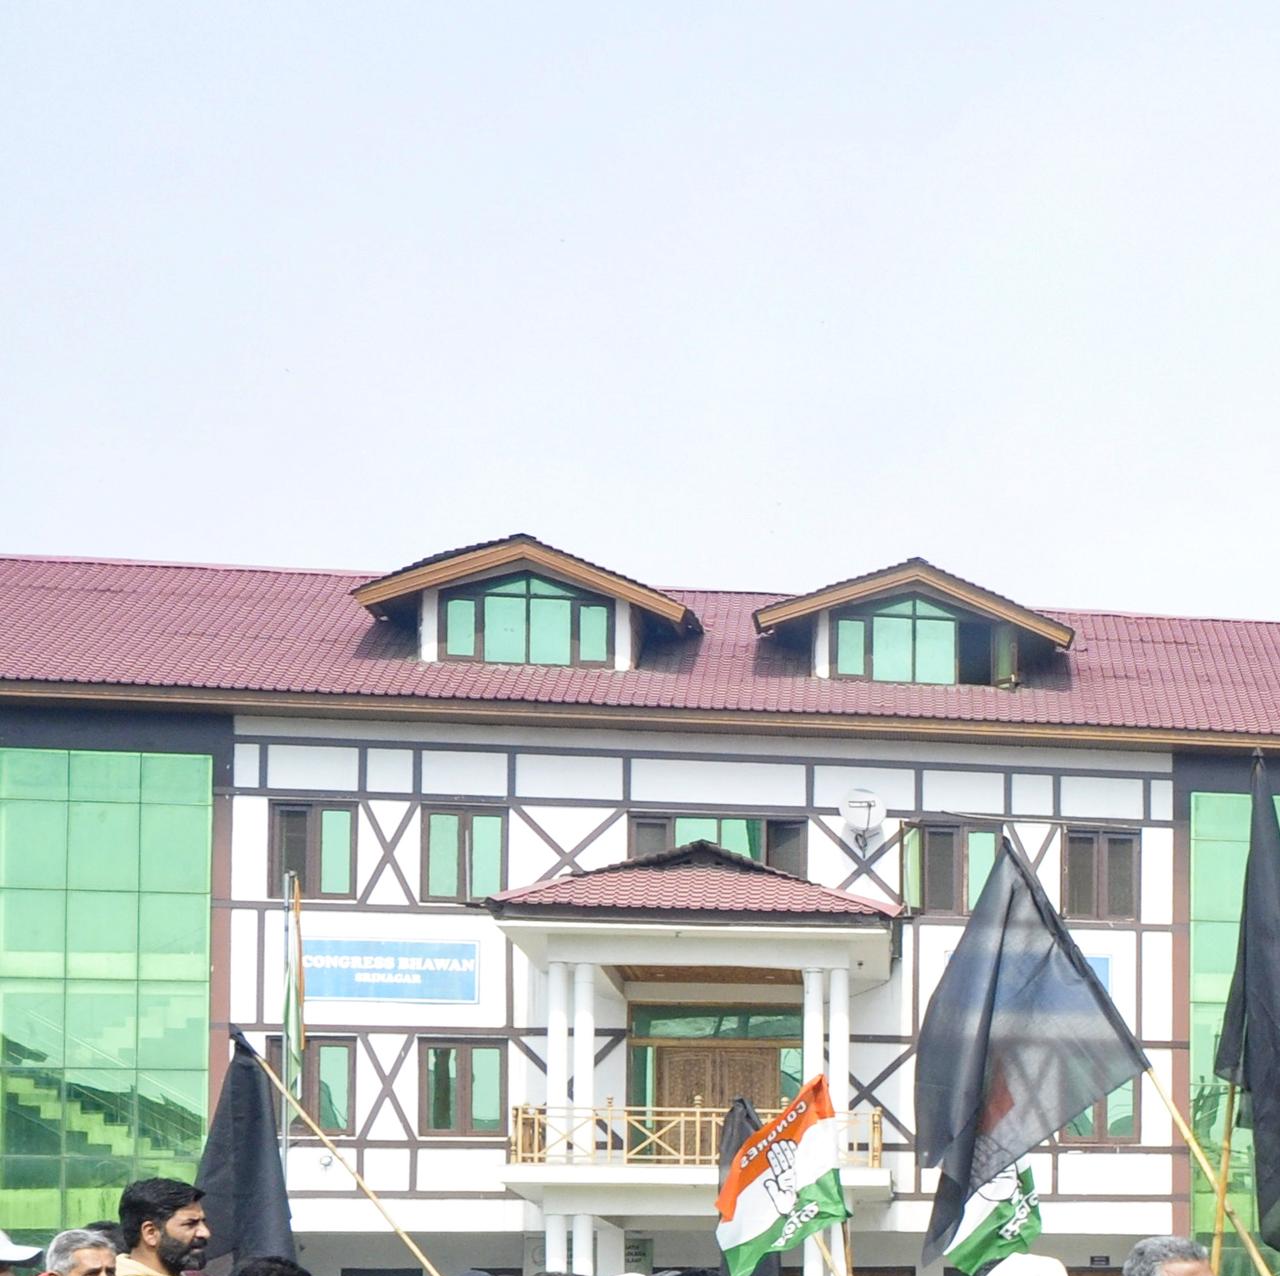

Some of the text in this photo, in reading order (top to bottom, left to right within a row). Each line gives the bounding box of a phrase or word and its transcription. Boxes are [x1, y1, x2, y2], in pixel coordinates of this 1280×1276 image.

[302, 955, 474, 971] CONGRESS BHAWAN
[355, 972, 422, 984] SRINAGAR
